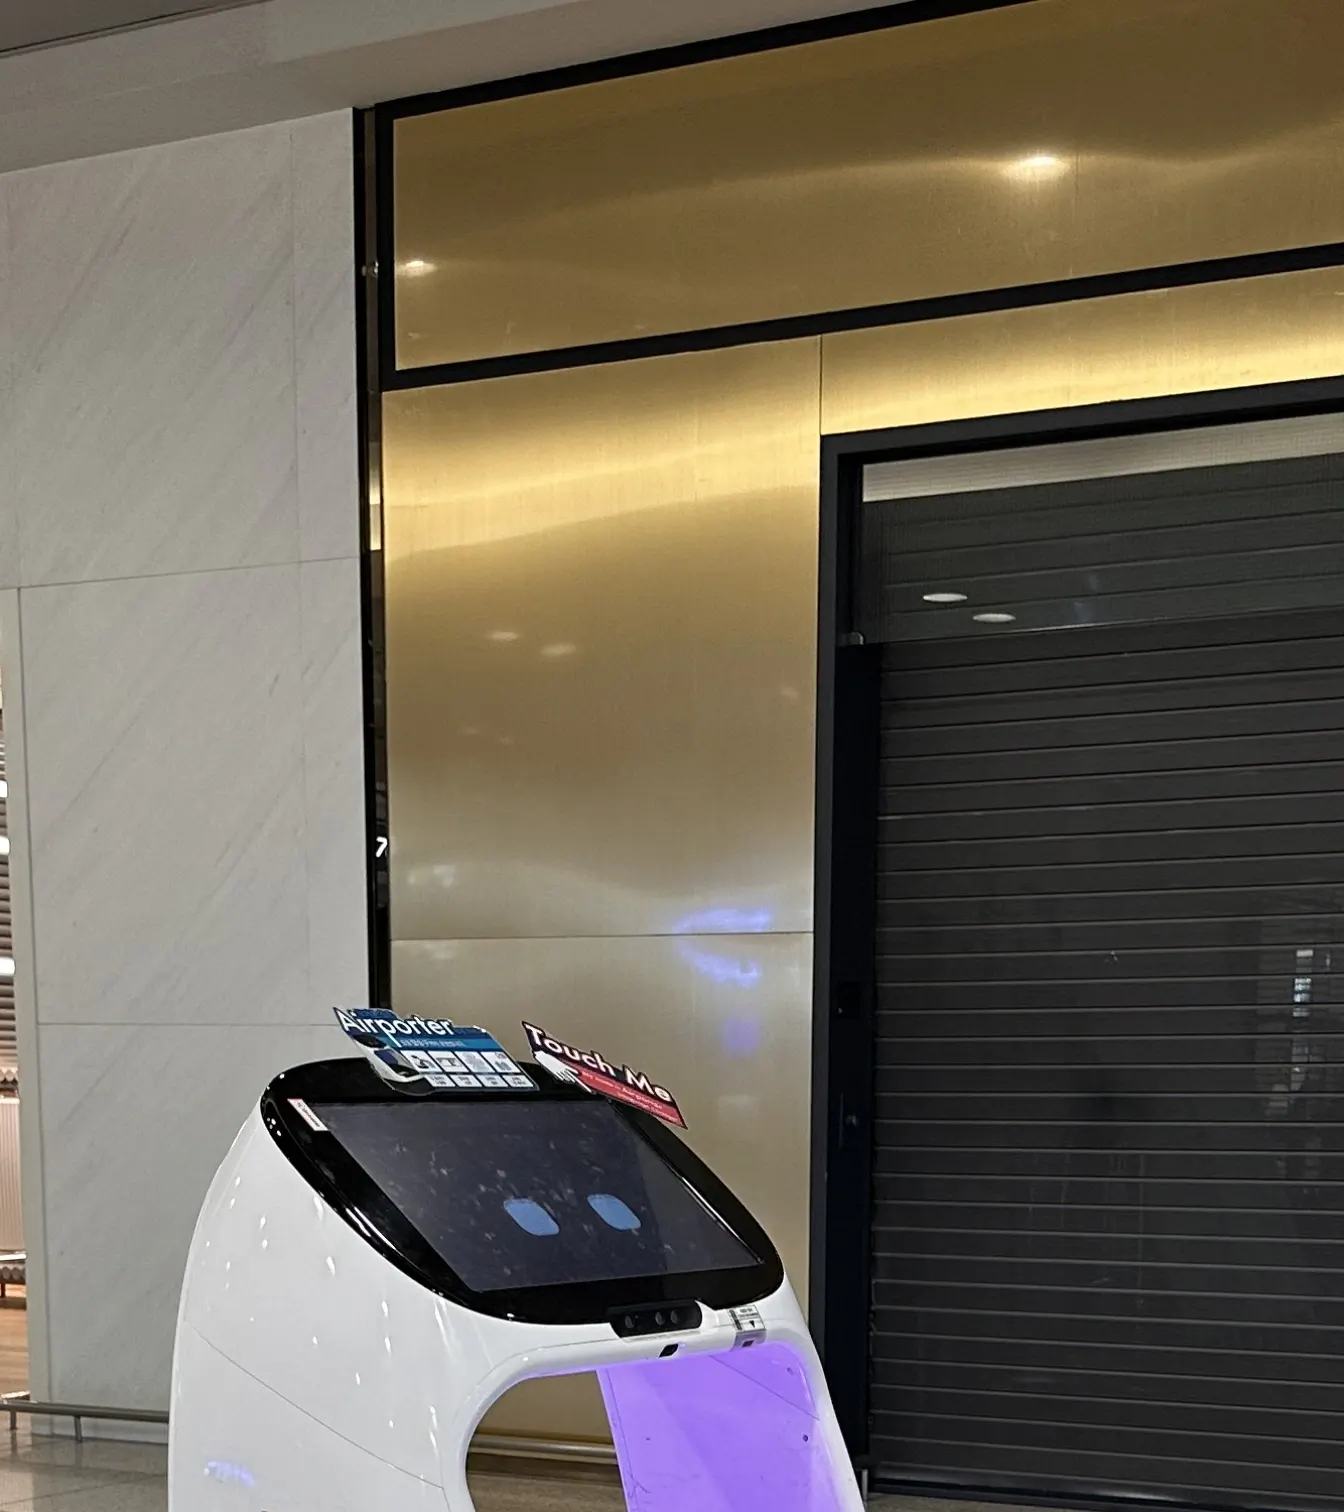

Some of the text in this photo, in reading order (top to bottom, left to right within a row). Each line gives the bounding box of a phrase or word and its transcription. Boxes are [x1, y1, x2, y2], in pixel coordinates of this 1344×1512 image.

[337, 1011, 455, 1048] Airporter
[525, 1024, 617, 1077] Touch
[624, 1066, 673, 1103] Me
